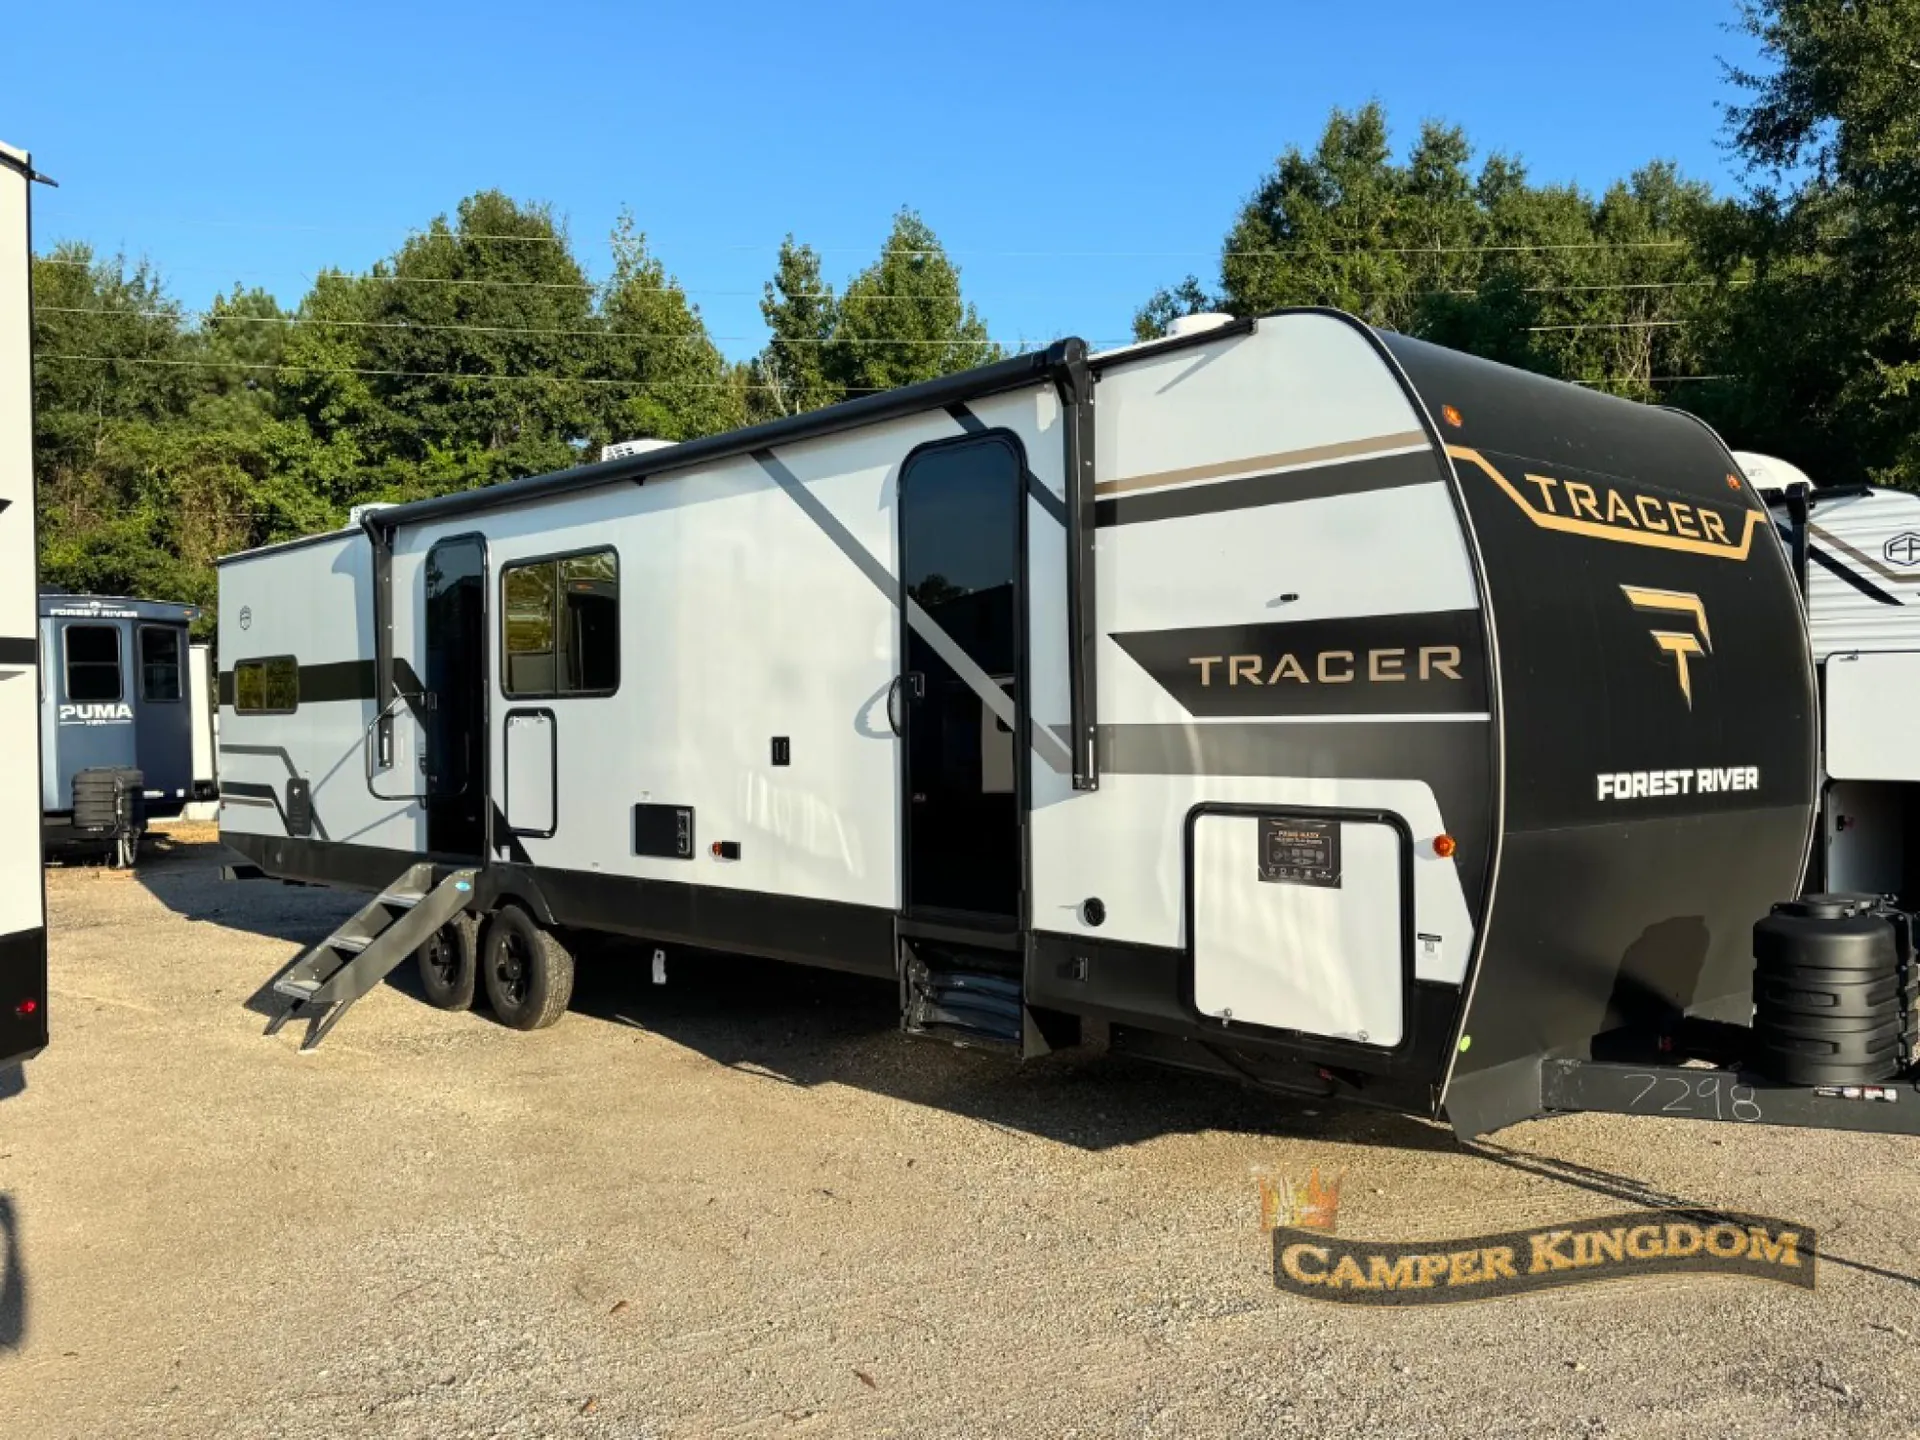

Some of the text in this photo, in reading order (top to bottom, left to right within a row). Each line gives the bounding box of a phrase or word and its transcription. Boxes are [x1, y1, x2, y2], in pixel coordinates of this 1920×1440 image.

[1524, 473, 1732, 545] TRACER
[1188, 646, 1464, 686] TRACER
[59, 703, 133, 719] PUMA
[1596, 765, 1759, 801] FOREST RIVER
[1623, 1073, 1762, 1122] 7298
